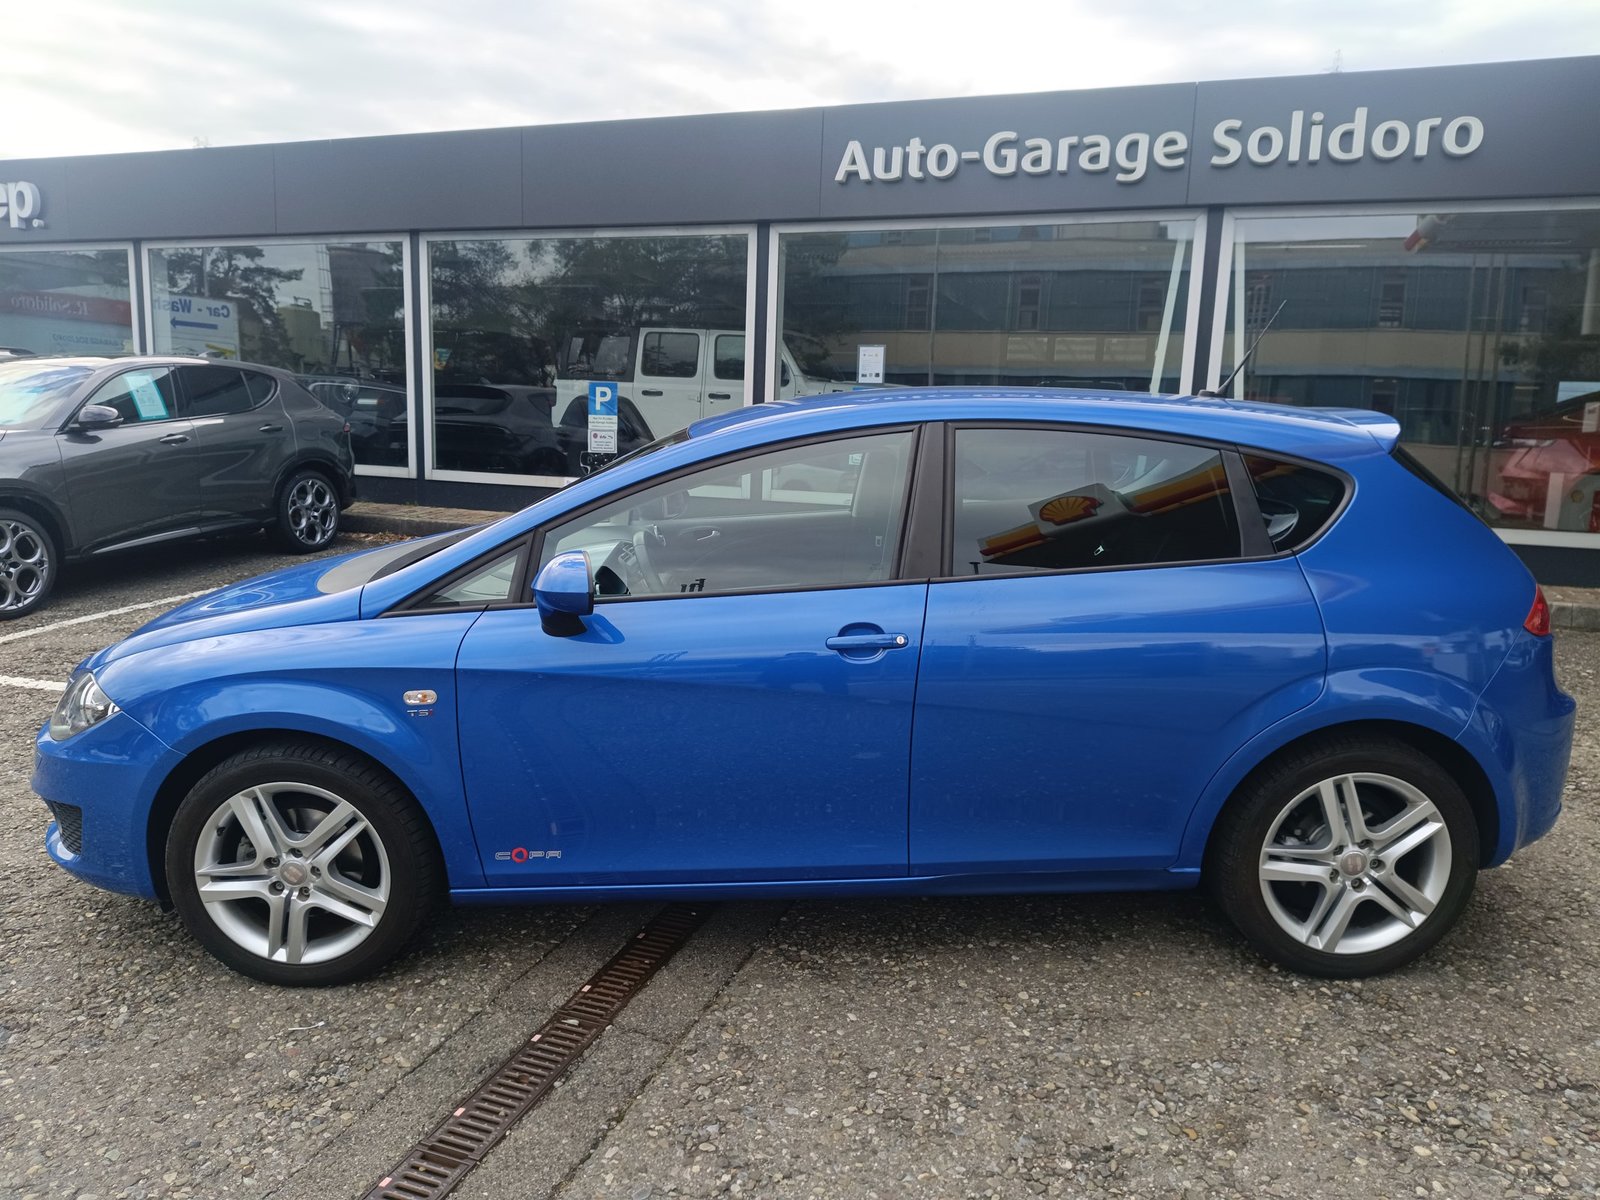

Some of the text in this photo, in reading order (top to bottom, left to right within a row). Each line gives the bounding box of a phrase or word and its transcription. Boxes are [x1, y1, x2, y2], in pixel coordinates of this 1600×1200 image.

[835, 107, 1485, 184] Auto-Garage Solidoro
[595, 386, 612, 411] P
[495, 847, 562, 863] COPA
